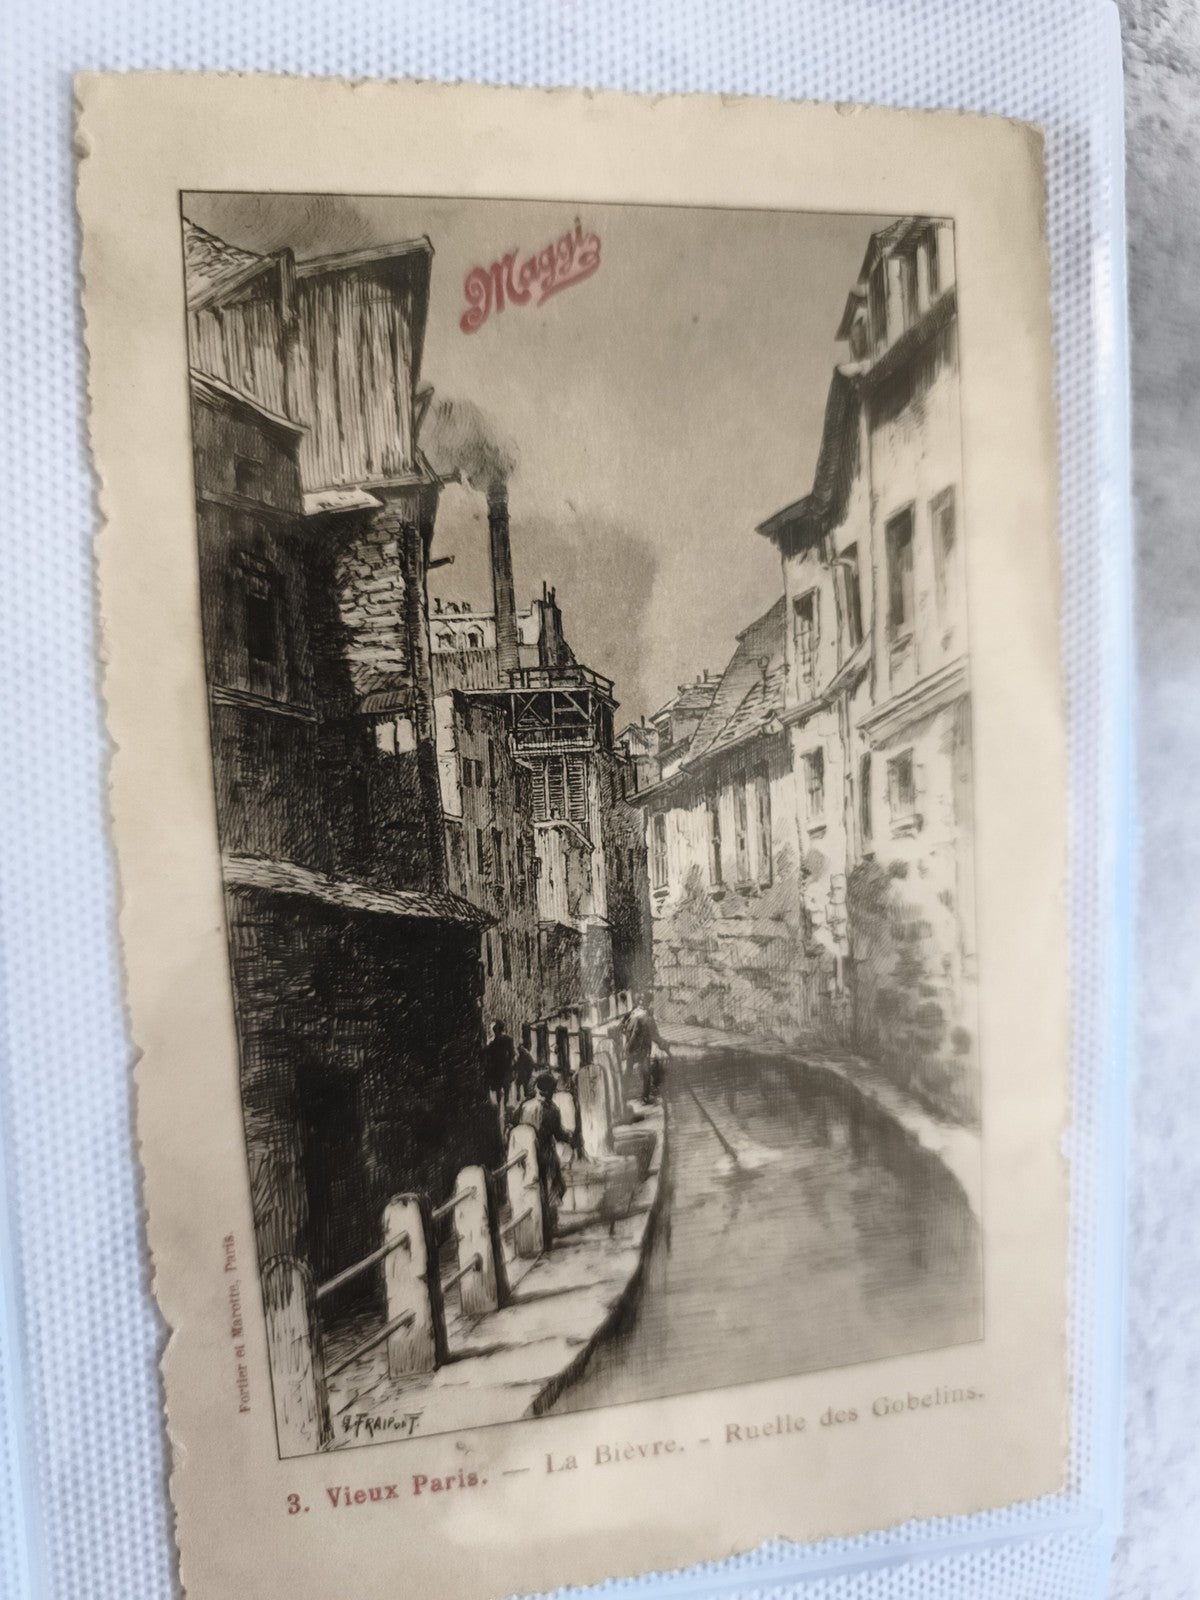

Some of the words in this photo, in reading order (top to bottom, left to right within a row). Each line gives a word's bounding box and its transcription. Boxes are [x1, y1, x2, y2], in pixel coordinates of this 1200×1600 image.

[459, 216, 601, 335] Maggi
[238, 1363, 250, 1413] Fortier
[287, 1493, 310, 1515] 3.
[326, 1484, 399, 1508] Vieux
[412, 1468, 488, 1496] Paris.
[546, 1453, 578, 1474] La
[594, 1438, 685, 1466] Bièvre.
[725, 1414, 806, 1443] Ruelle
[819, 1406, 858, 1428] des
[871, 1384, 985, 1417] Gobelins.
